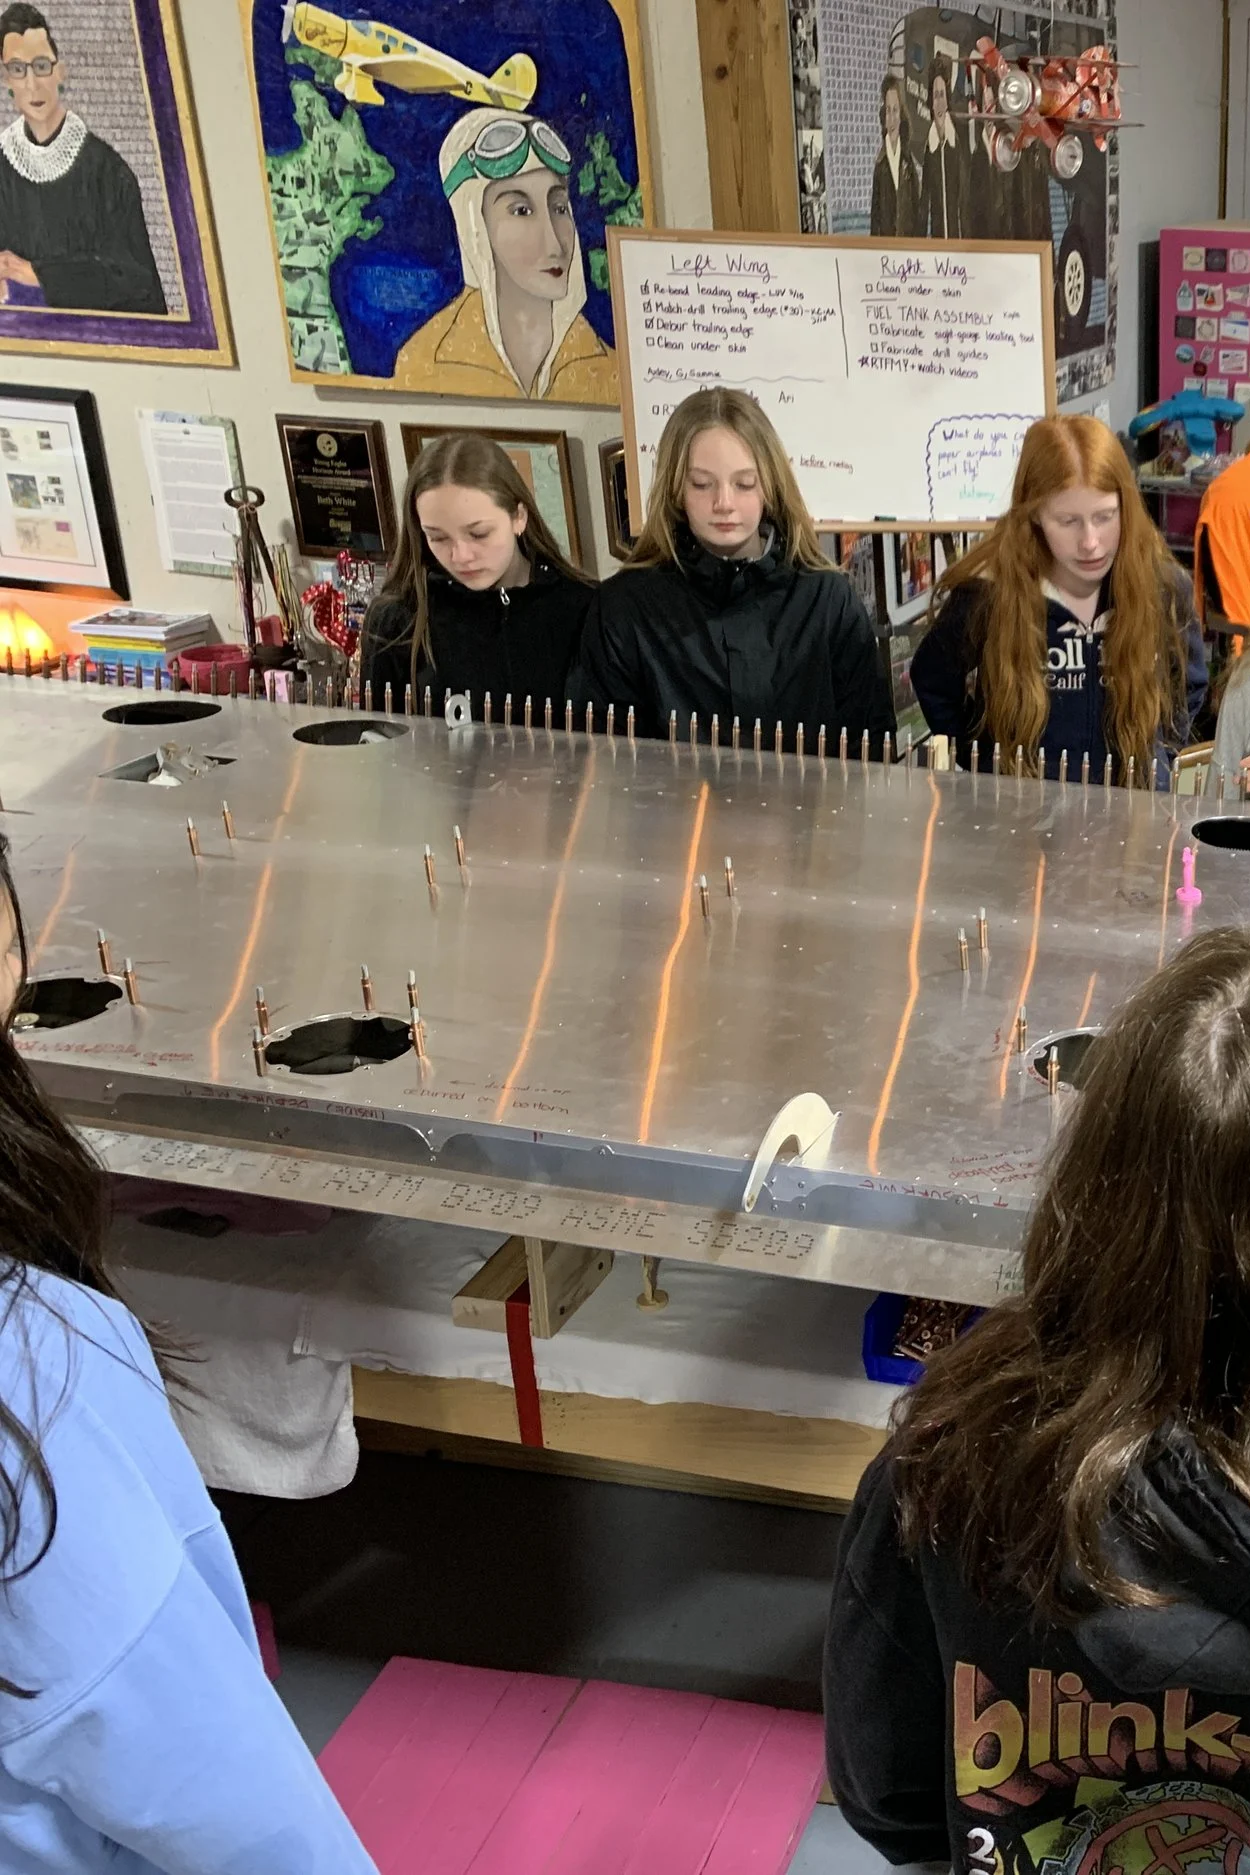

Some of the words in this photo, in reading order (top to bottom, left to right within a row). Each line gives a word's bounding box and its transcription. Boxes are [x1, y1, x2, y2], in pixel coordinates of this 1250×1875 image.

[671, 254, 716, 277] Left
[726, 253, 771, 283] Wing
[880, 255, 925, 283] Right
[935, 256, 967, 285] Wing
[653, 283, 689, 296] Re-bend
[697, 282, 732, 303] leading
[737, 288, 760, 303] edge
[876, 281, 901, 294] Clean
[908, 285, 933, 296] under
[942, 286, 961, 298] skin
[655, 302, 705, 315] Match-drill
[712, 303, 746, 320] trailing
[753, 305, 778, 318] edge
[866, 305, 893, 320] FUEL
[900, 305, 929, 322] TANK
[933, 309, 993, 325] ASSEMBLY
[693, 319, 729, 340] trailing
[730, 322, 754, 338] edge
[880, 323, 925, 339] Fabricate
[657, 336, 684, 351] Clean
[691, 338, 720, 352] under
[728, 342, 747, 353] skin
[881, 342, 923, 357] Fabricate
[932, 347, 951, 359] drill
[957, 348, 989, 363] guides
[918, 360, 945, 376] watch
[949, 366, 978, 379] videos
[943, 428, 969, 441] What
[974, 428, 984, 440] do
[990, 432, 1008, 450] you
[799, 455, 827, 468] before
[938, 450, 960, 466] paper
[322, 1165, 425, 1202] ASTM
[440, 1183, 542, 1220] B209
[560, 1202, 667, 1239] ASME
[687, 1219, 815, 1260] SB209
